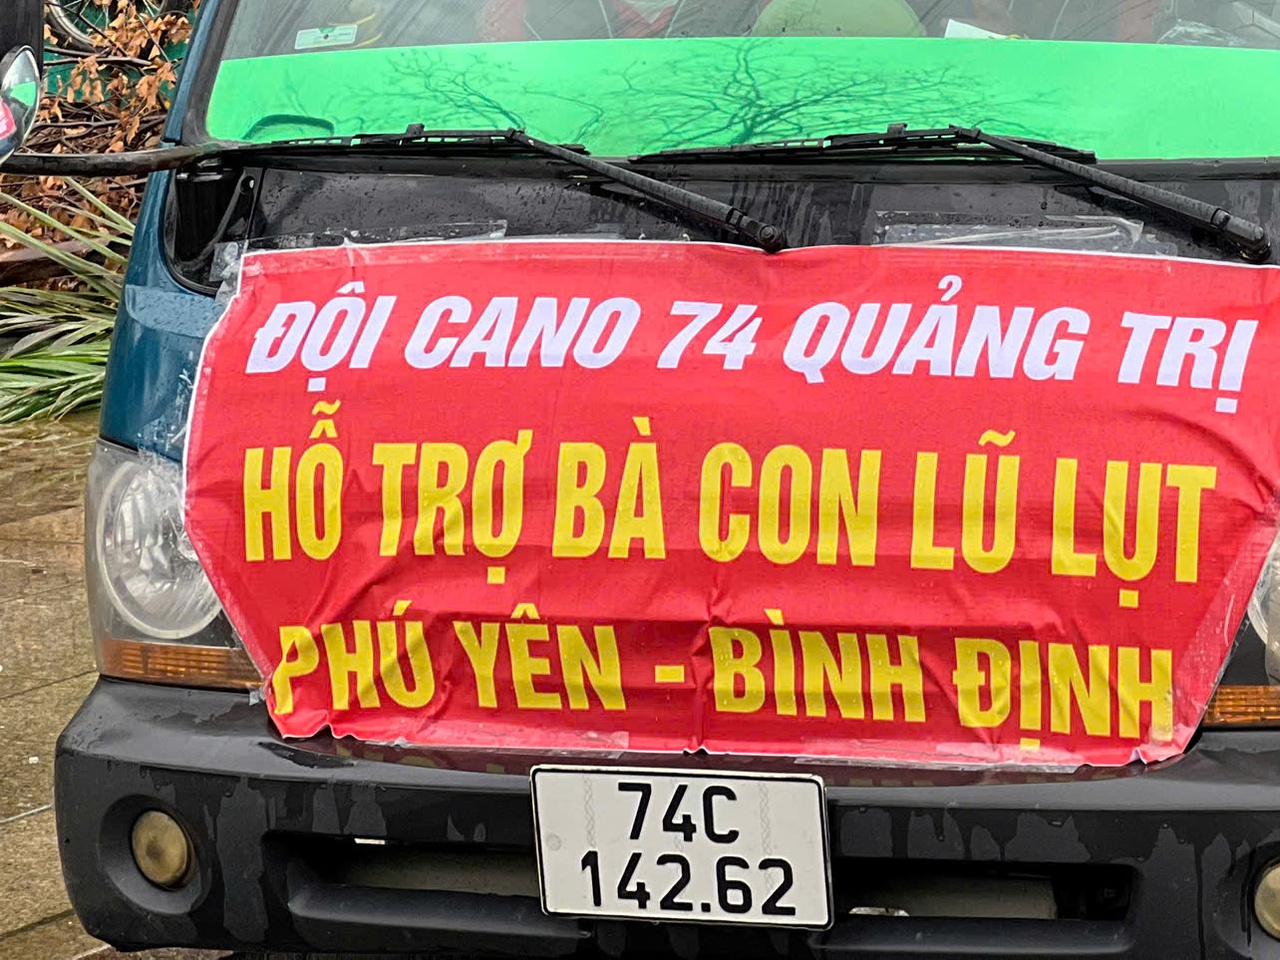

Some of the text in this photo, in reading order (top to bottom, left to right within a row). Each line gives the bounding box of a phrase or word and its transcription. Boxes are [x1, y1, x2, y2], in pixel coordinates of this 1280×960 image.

[245, 274, 1259, 413] ĐỘI CANO 74 QUẢNG TRỊ
[243, 399, 1217, 609] HỖ TRỢ BÀ CON LŨ LỤT
[274, 600, 437, 715] PHÚ
[453, 602, 626, 710] YÊN
[707, 608, 925, 723] BÌNH
[952, 636, 1174, 751] ĐỊNH
[618, 782, 739, 844] 74C
[581, 850, 796, 916] 142.62
